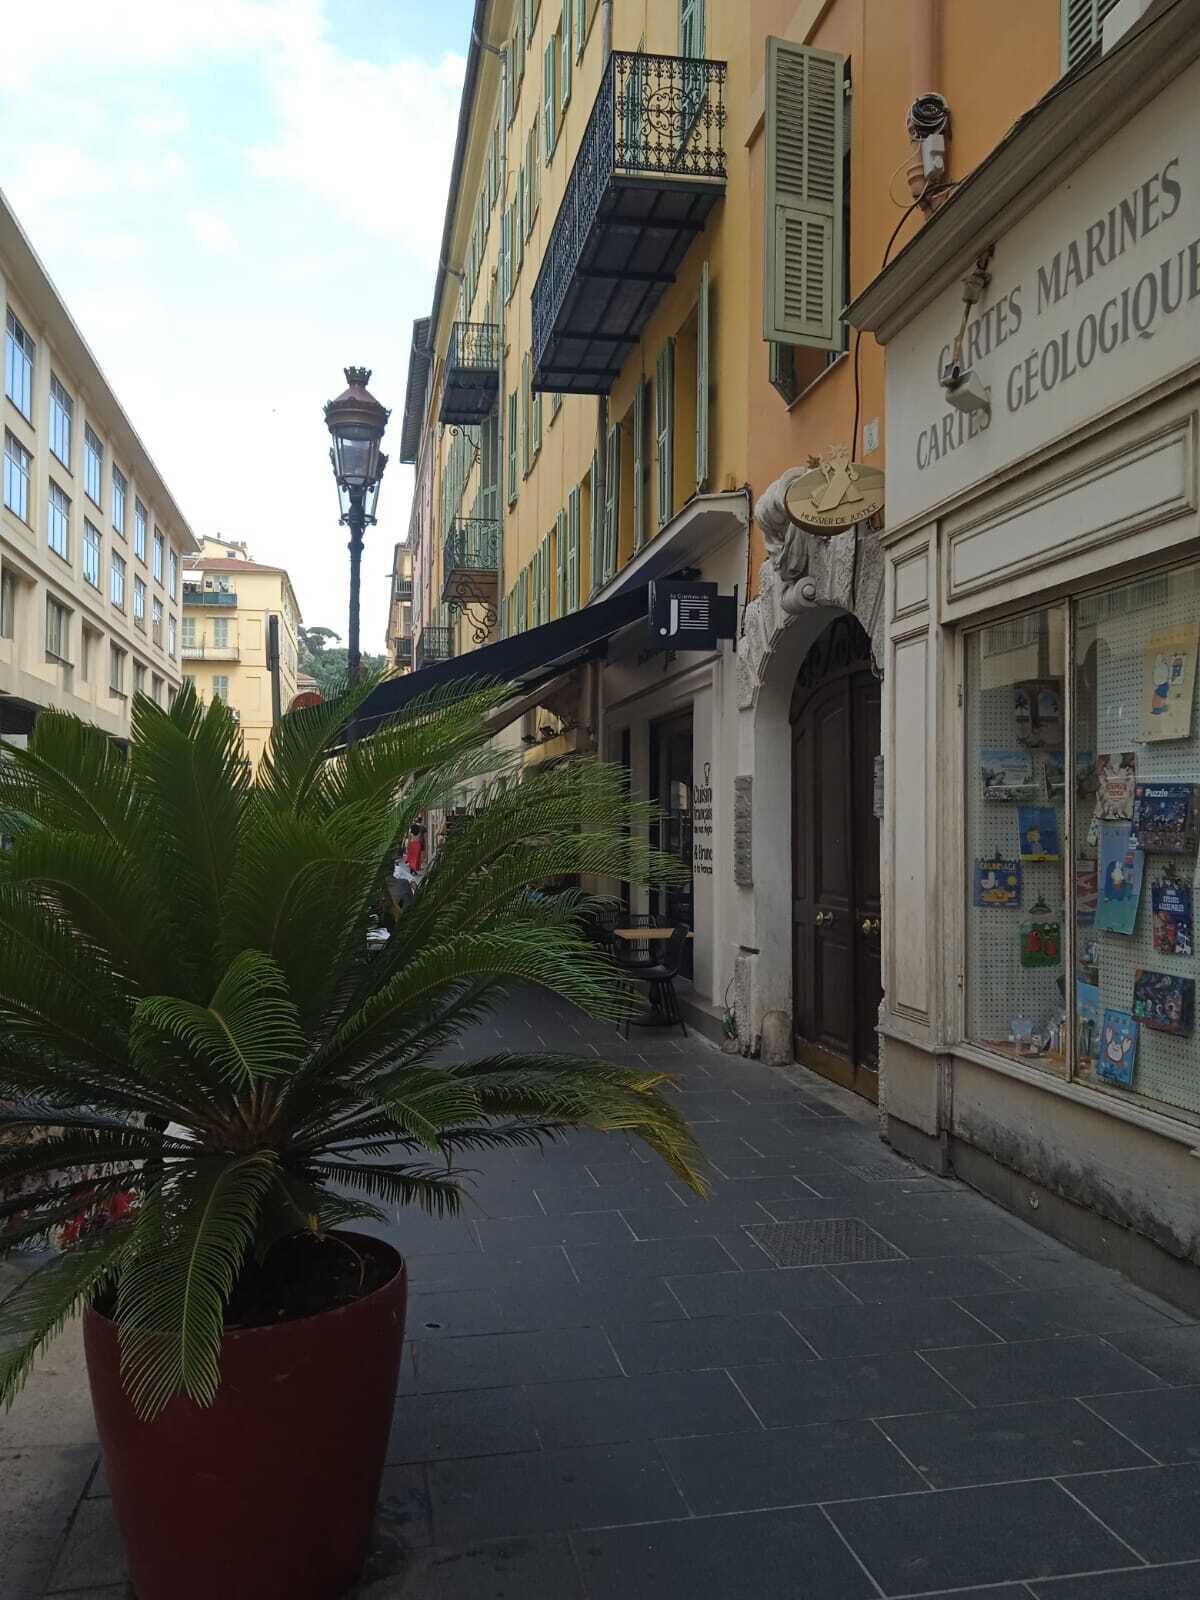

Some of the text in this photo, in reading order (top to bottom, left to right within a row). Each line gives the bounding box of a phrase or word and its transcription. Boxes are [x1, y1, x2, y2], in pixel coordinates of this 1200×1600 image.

[1036, 157, 1182, 316] MARINES
[849, 501, 880, 519] JUSTICE
[693, 784, 713, 804] Cuisin
[1144, 788, 1169, 798] Puzzle
[693, 806, 713, 824] français
[698, 843, 713, 861] Brunc
